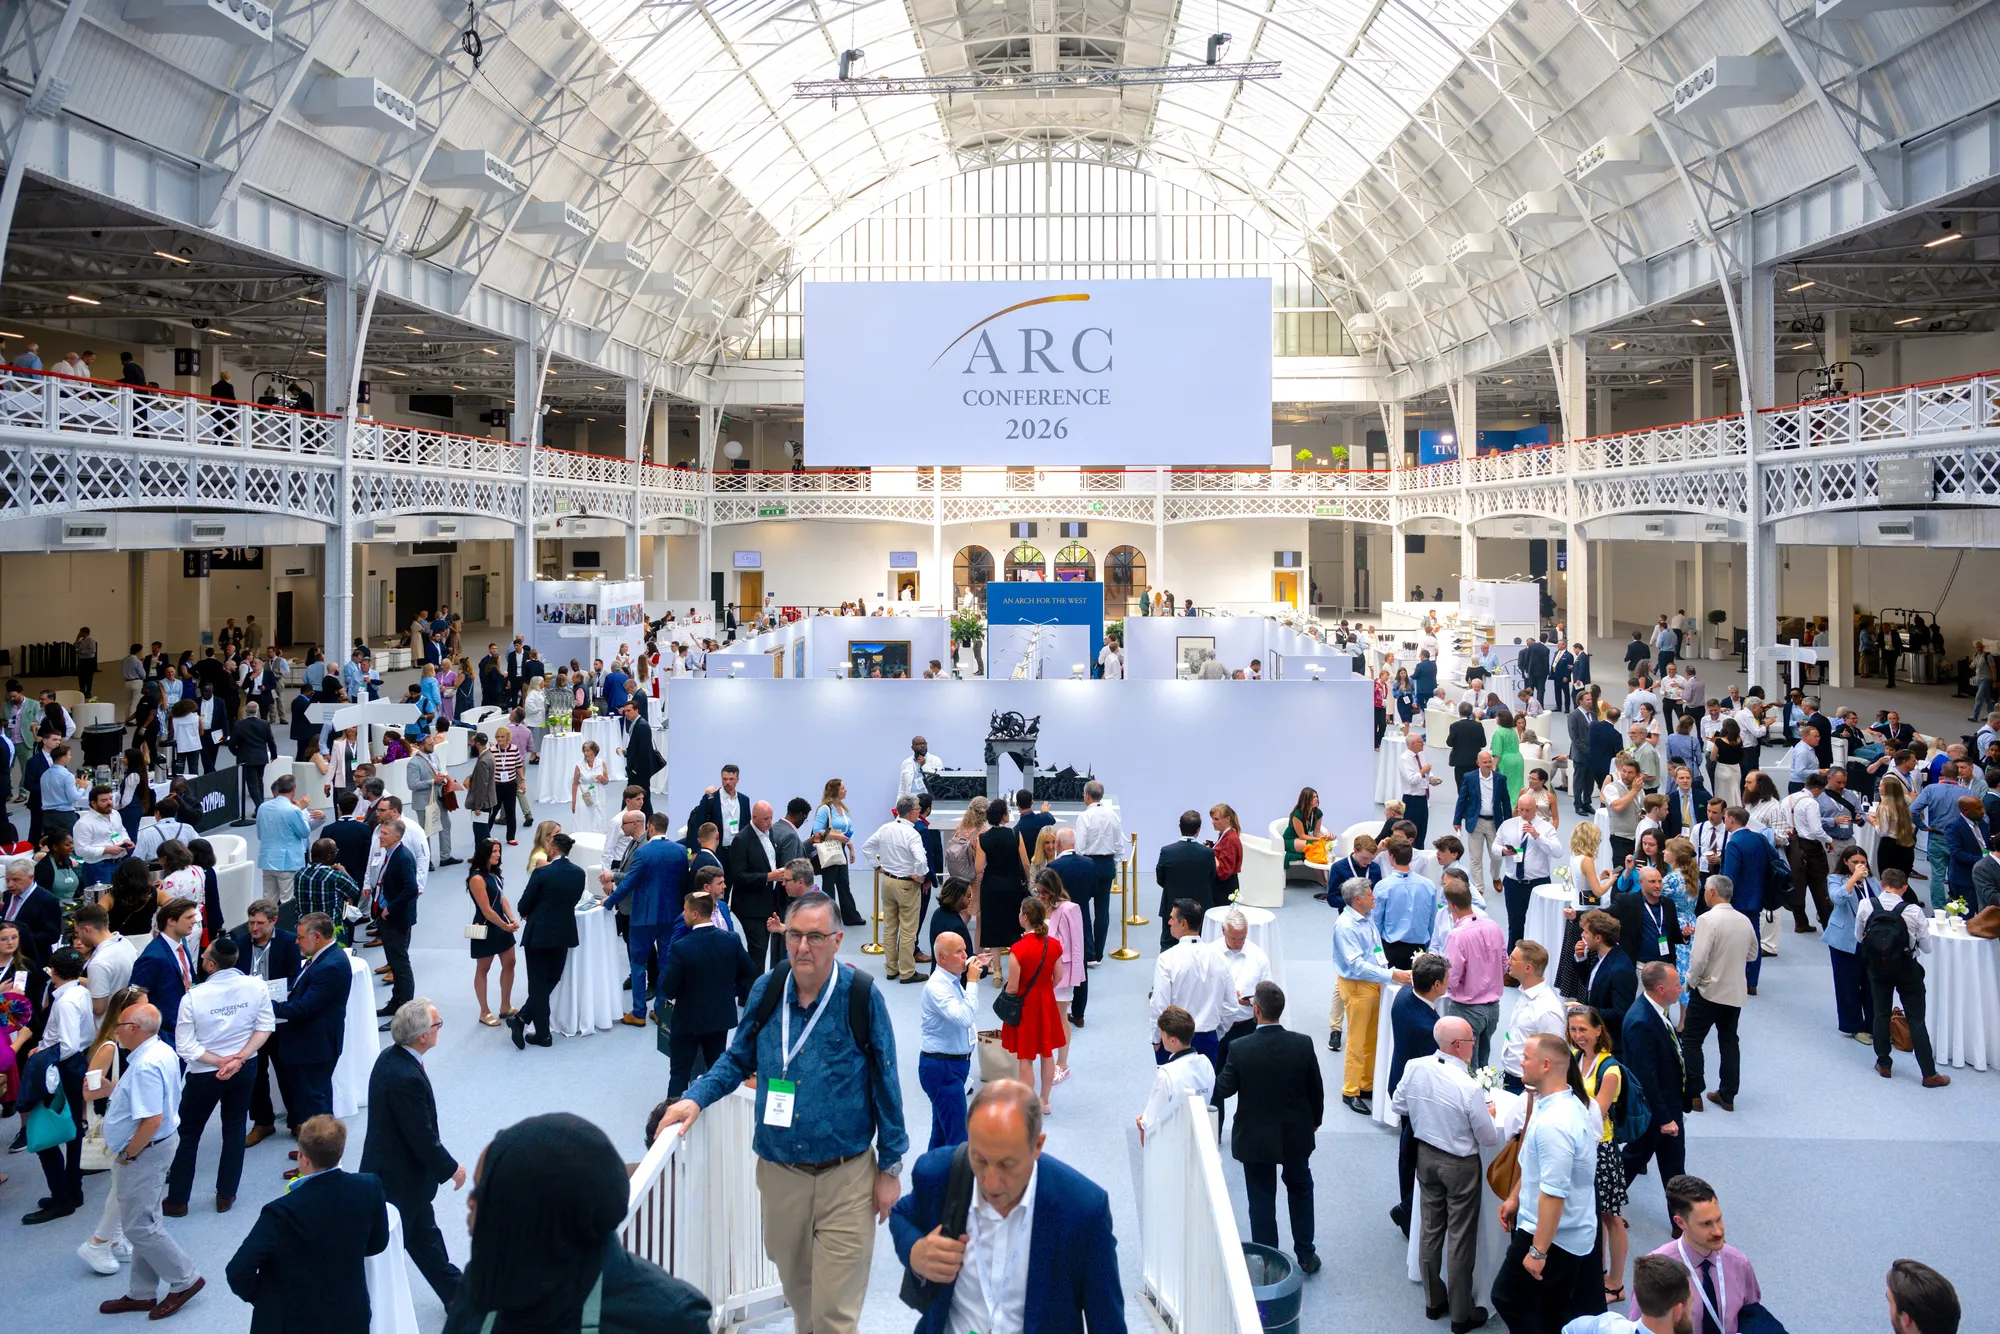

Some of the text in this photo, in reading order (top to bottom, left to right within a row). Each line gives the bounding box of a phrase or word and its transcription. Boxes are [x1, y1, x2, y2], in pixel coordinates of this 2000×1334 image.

[962, 327, 1113, 374] ARC
[962, 388, 1111, 407] CONFERENCE
[1005, 417, 1069, 440] 2026
[1432, 445, 1459, 455] TIM
[553, 592, 569, 600] ARC
[200, 791, 226, 814] LYMPIA
[210, 1001, 249, 1015] CONFERENCE
[221, 1009, 238, 1017] HOST
